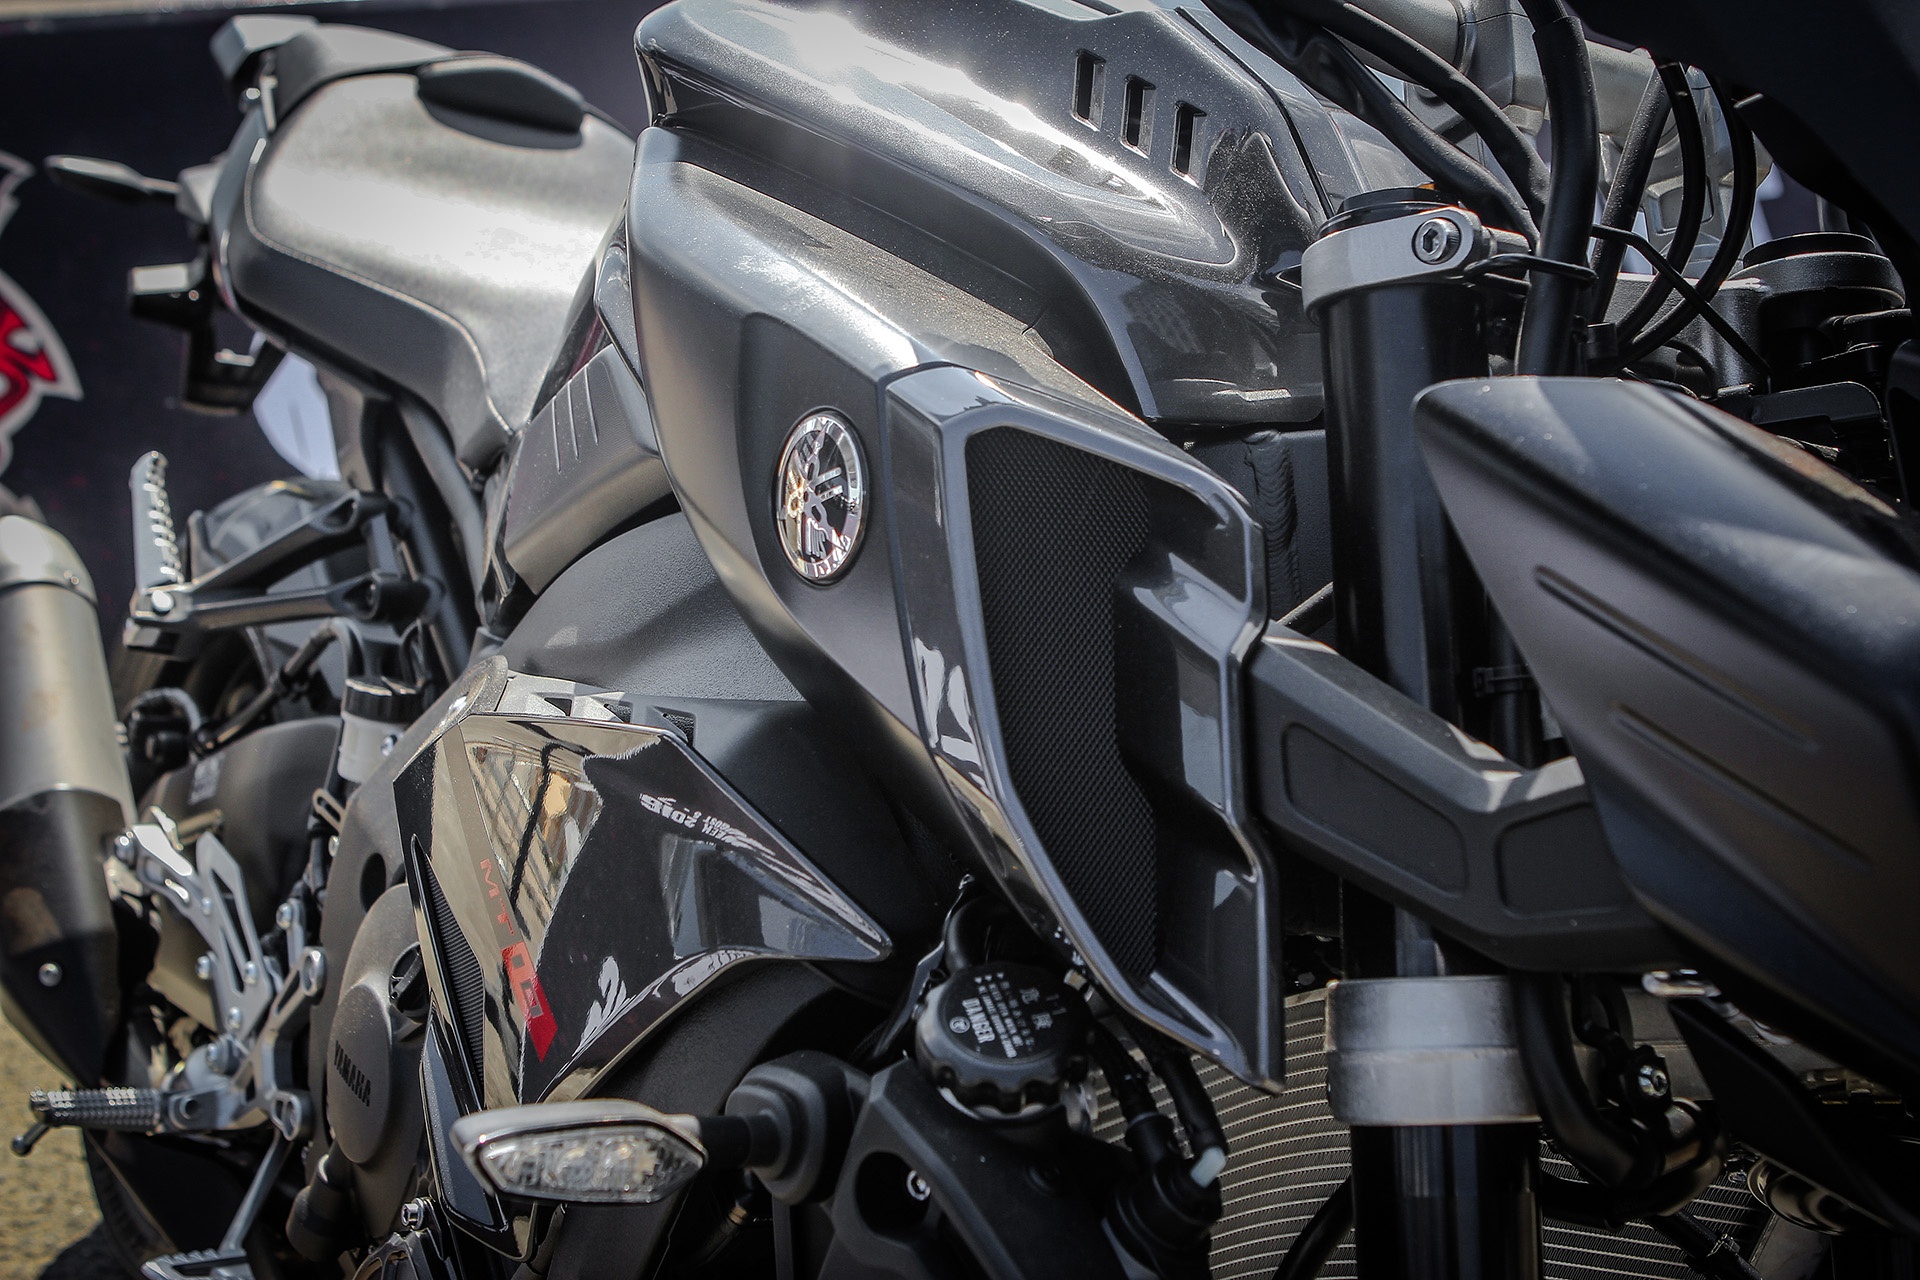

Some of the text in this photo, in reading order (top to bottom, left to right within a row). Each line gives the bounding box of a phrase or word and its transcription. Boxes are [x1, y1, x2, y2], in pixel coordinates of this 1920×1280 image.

[480, 858, 515, 935] MT
[962, 997, 996, 1044] DANGER
[334, 1040, 371, 1107] YAMAHA
